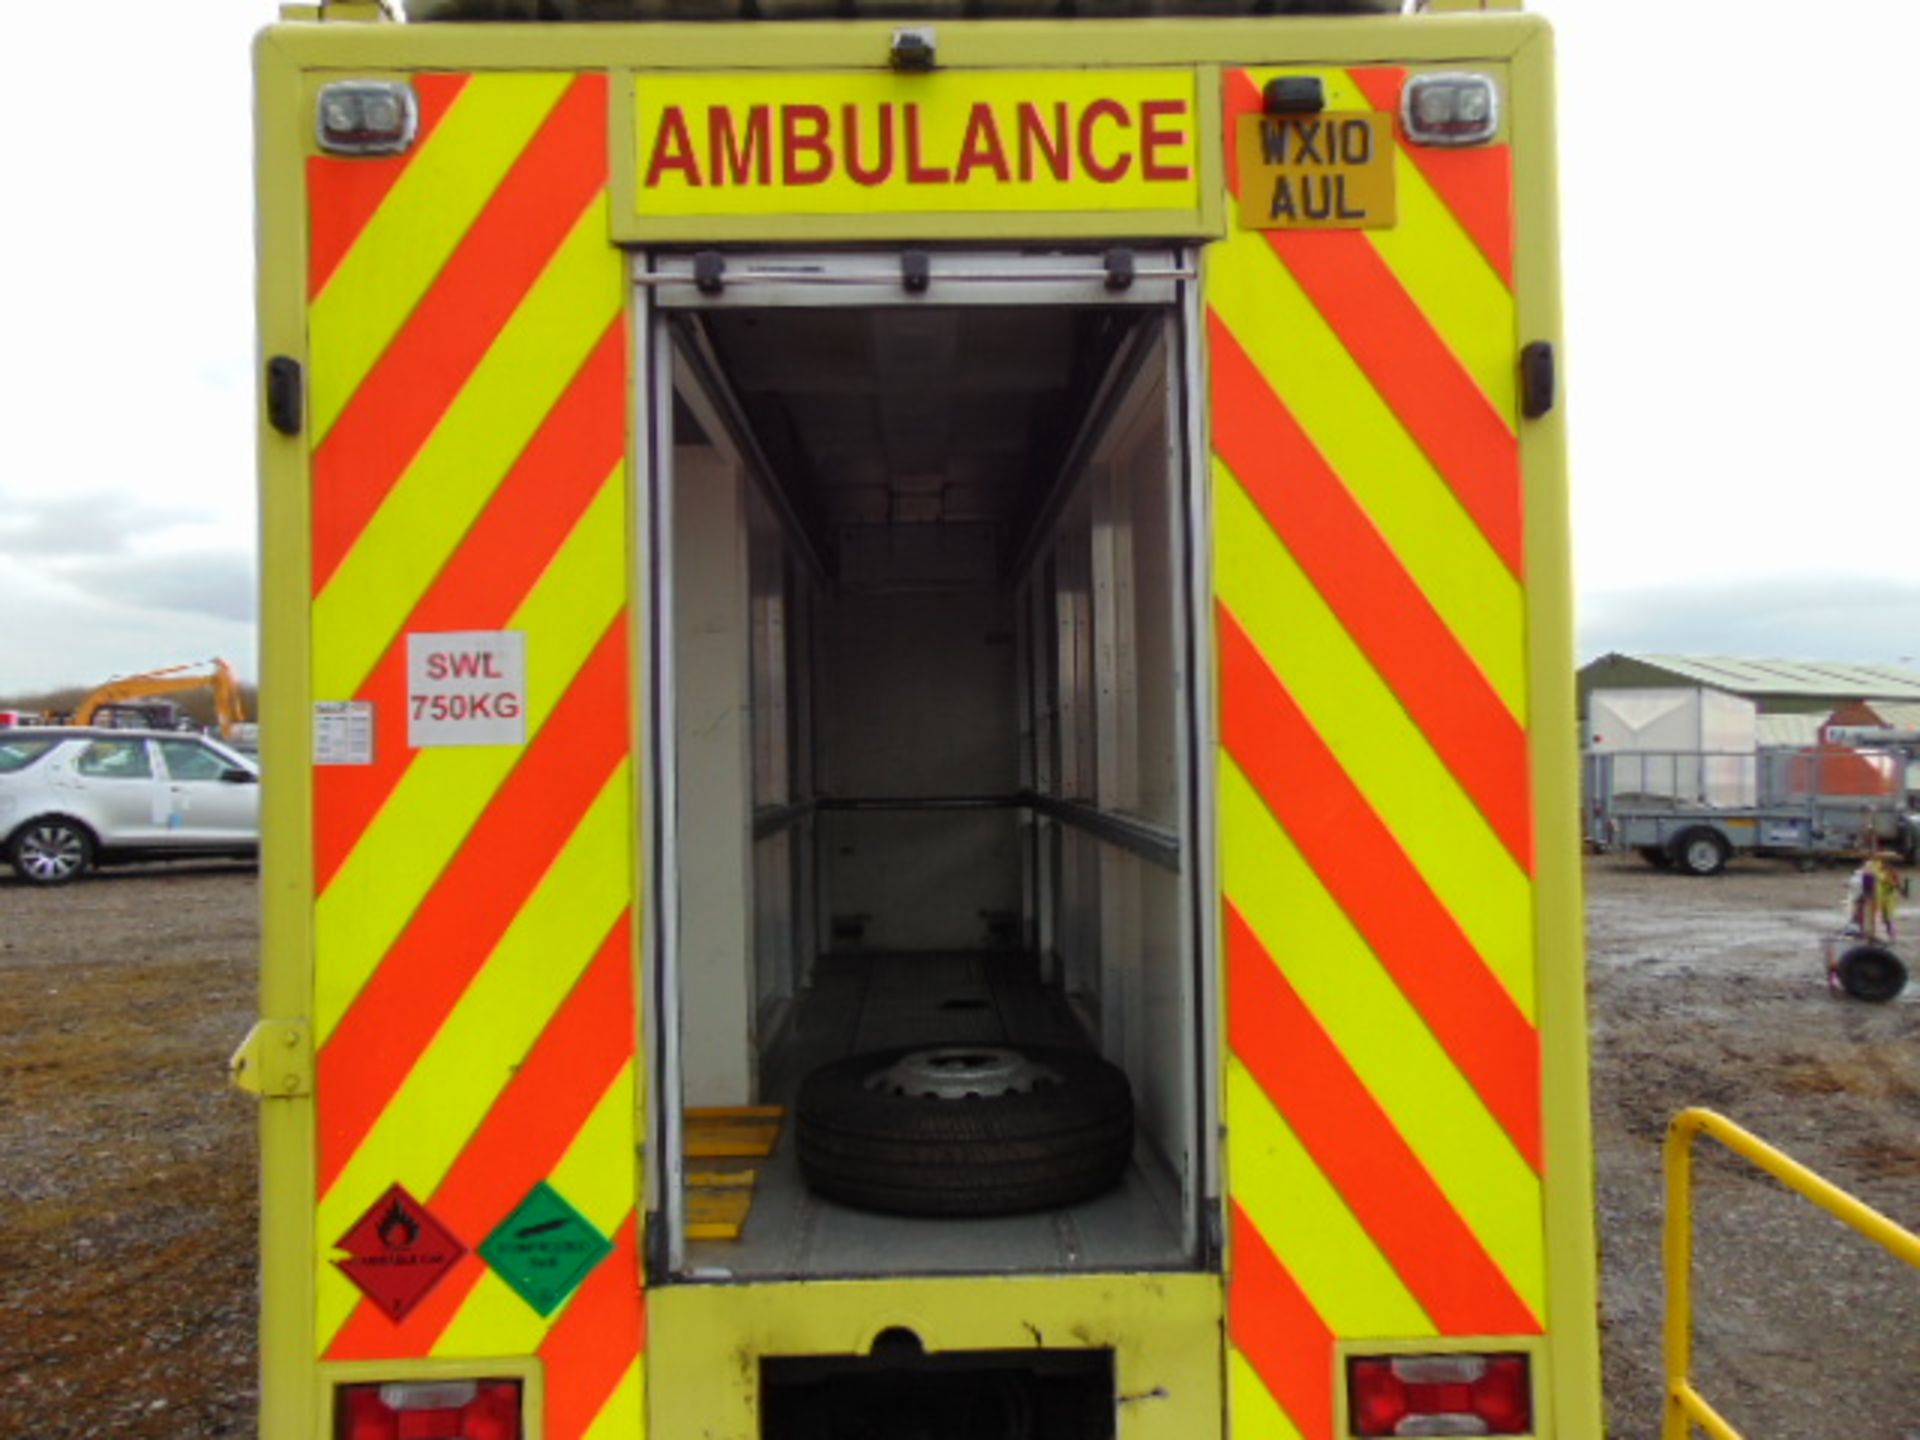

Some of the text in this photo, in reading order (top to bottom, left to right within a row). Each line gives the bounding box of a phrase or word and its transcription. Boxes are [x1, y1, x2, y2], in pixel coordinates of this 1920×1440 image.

[644, 98, 1192, 188] AMBULANCE
[1260, 119, 1369, 165] WX10
[1271, 174, 1365, 220] AUL
[426, 651, 503, 680] SWL
[411, 692, 519, 721] 750KG
